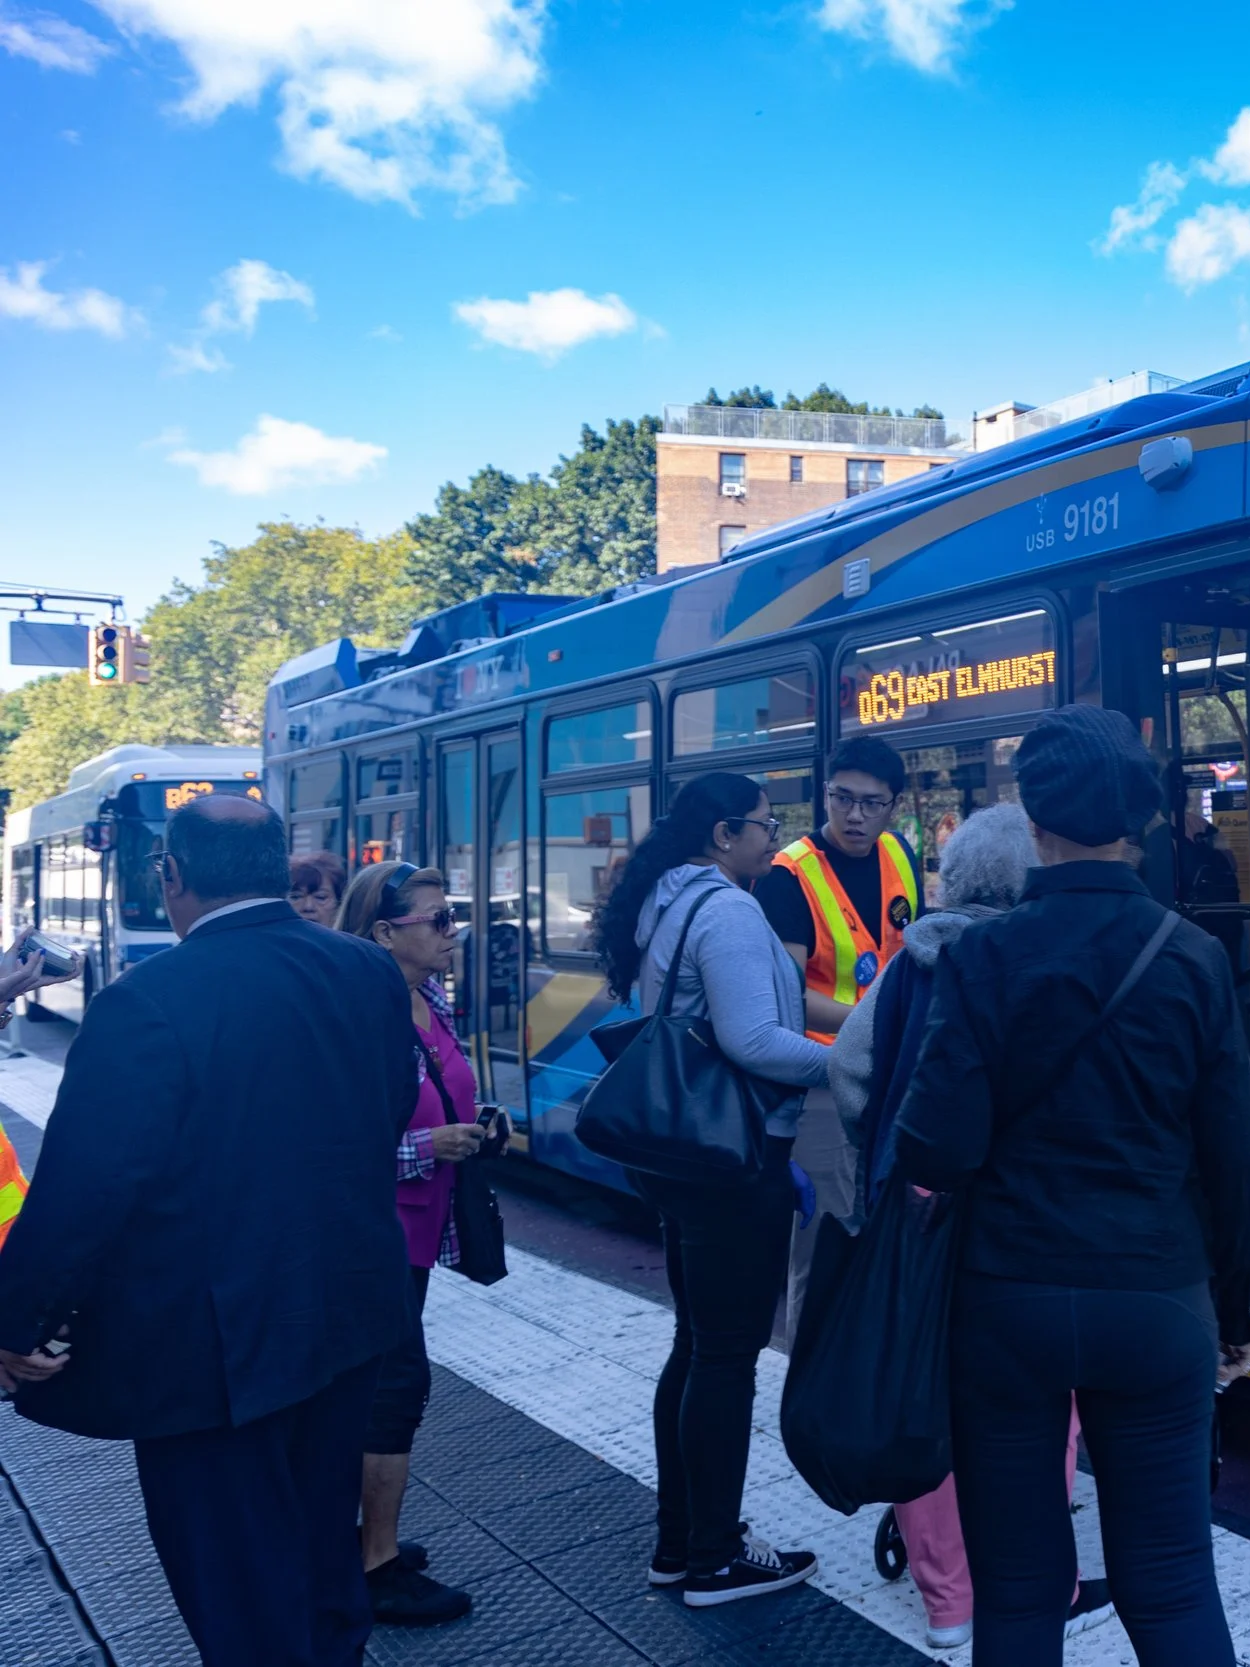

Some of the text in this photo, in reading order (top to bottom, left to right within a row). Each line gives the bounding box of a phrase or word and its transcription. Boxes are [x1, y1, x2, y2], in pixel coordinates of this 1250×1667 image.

[1064, 491, 1119, 542] 9181
[1026, 529, 1055, 552] USB
[476, 655, 504, 695] NY
[858, 671, 905, 724] Q69
[906, 670, 950, 705] EAST
[955, 651, 1055, 697] ELMHURST
